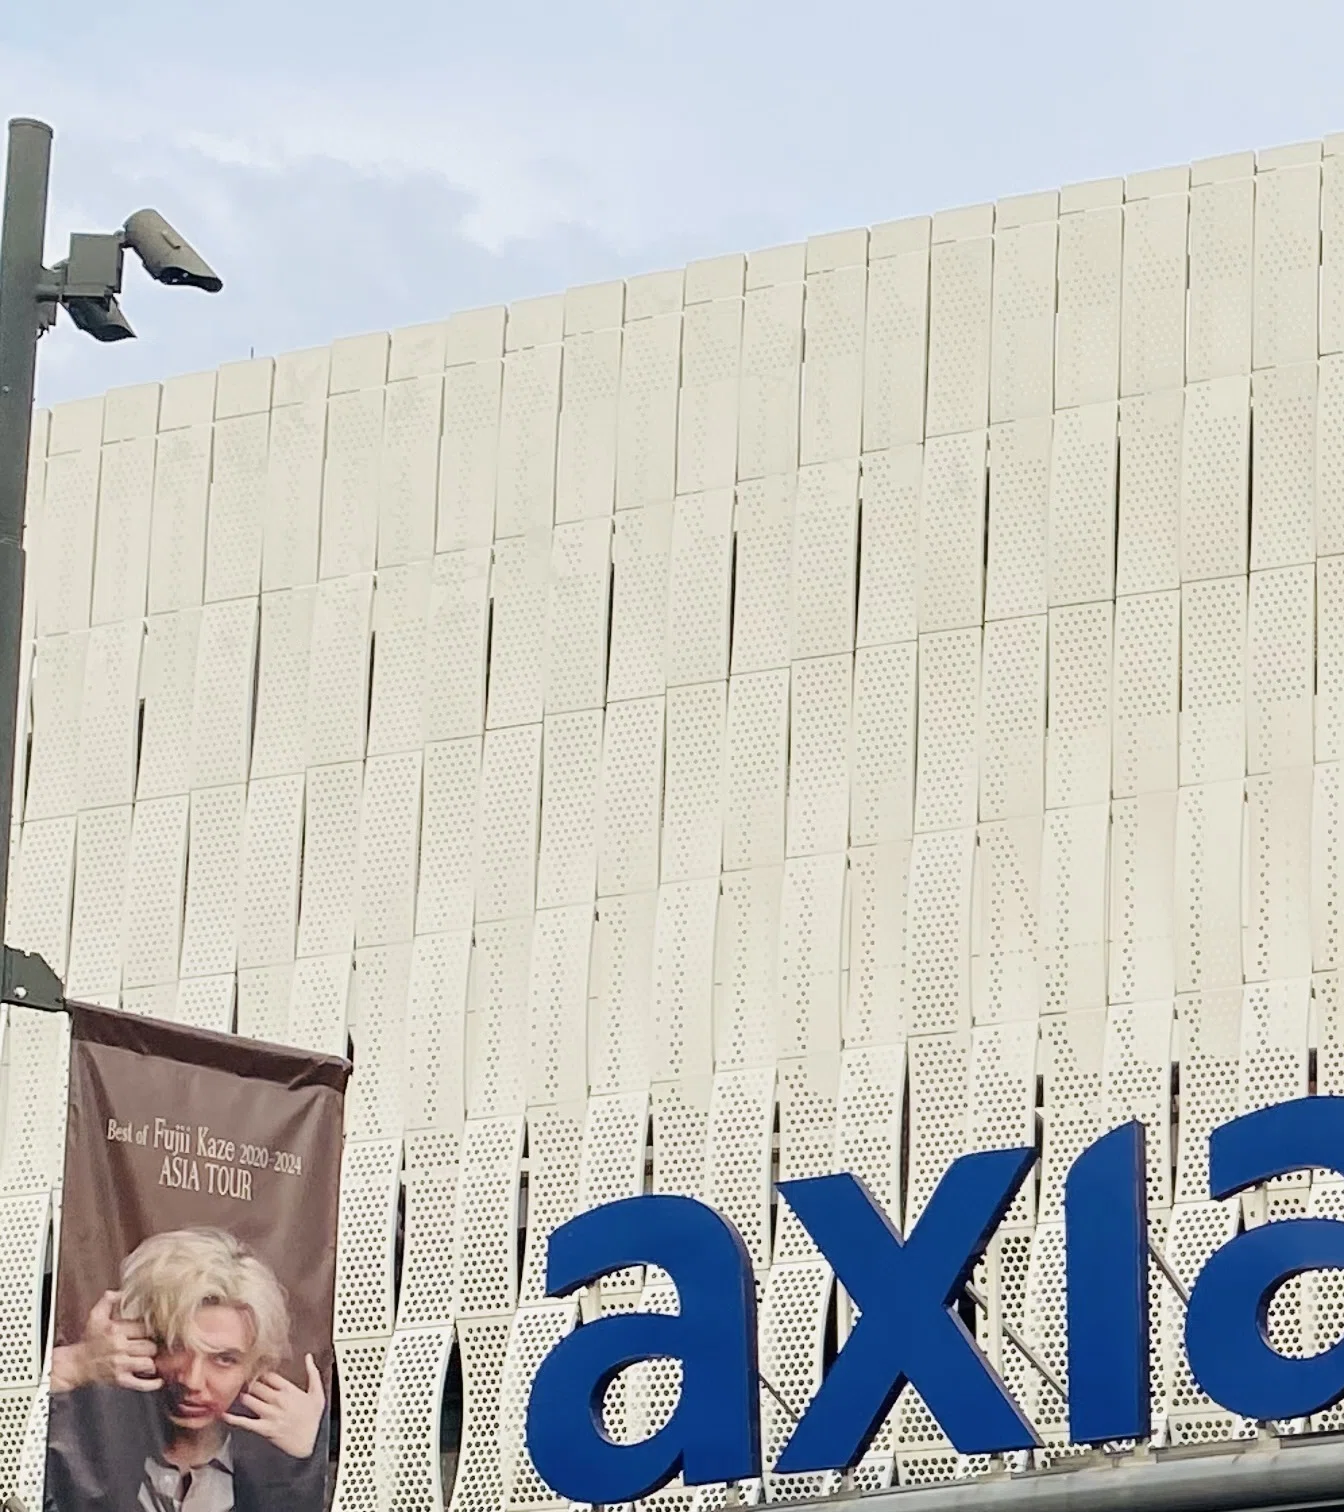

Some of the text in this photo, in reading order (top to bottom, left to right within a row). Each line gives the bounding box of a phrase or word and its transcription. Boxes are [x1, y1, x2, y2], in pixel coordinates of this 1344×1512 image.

[107, 1119, 132, 1142] Best
[136, 1125, 149, 1145] of
[154, 1117, 190, 1155] Fujii
[197, 1126, 235, 1161] Kaze
[159, 1156, 252, 1200] ASIA TOUR
